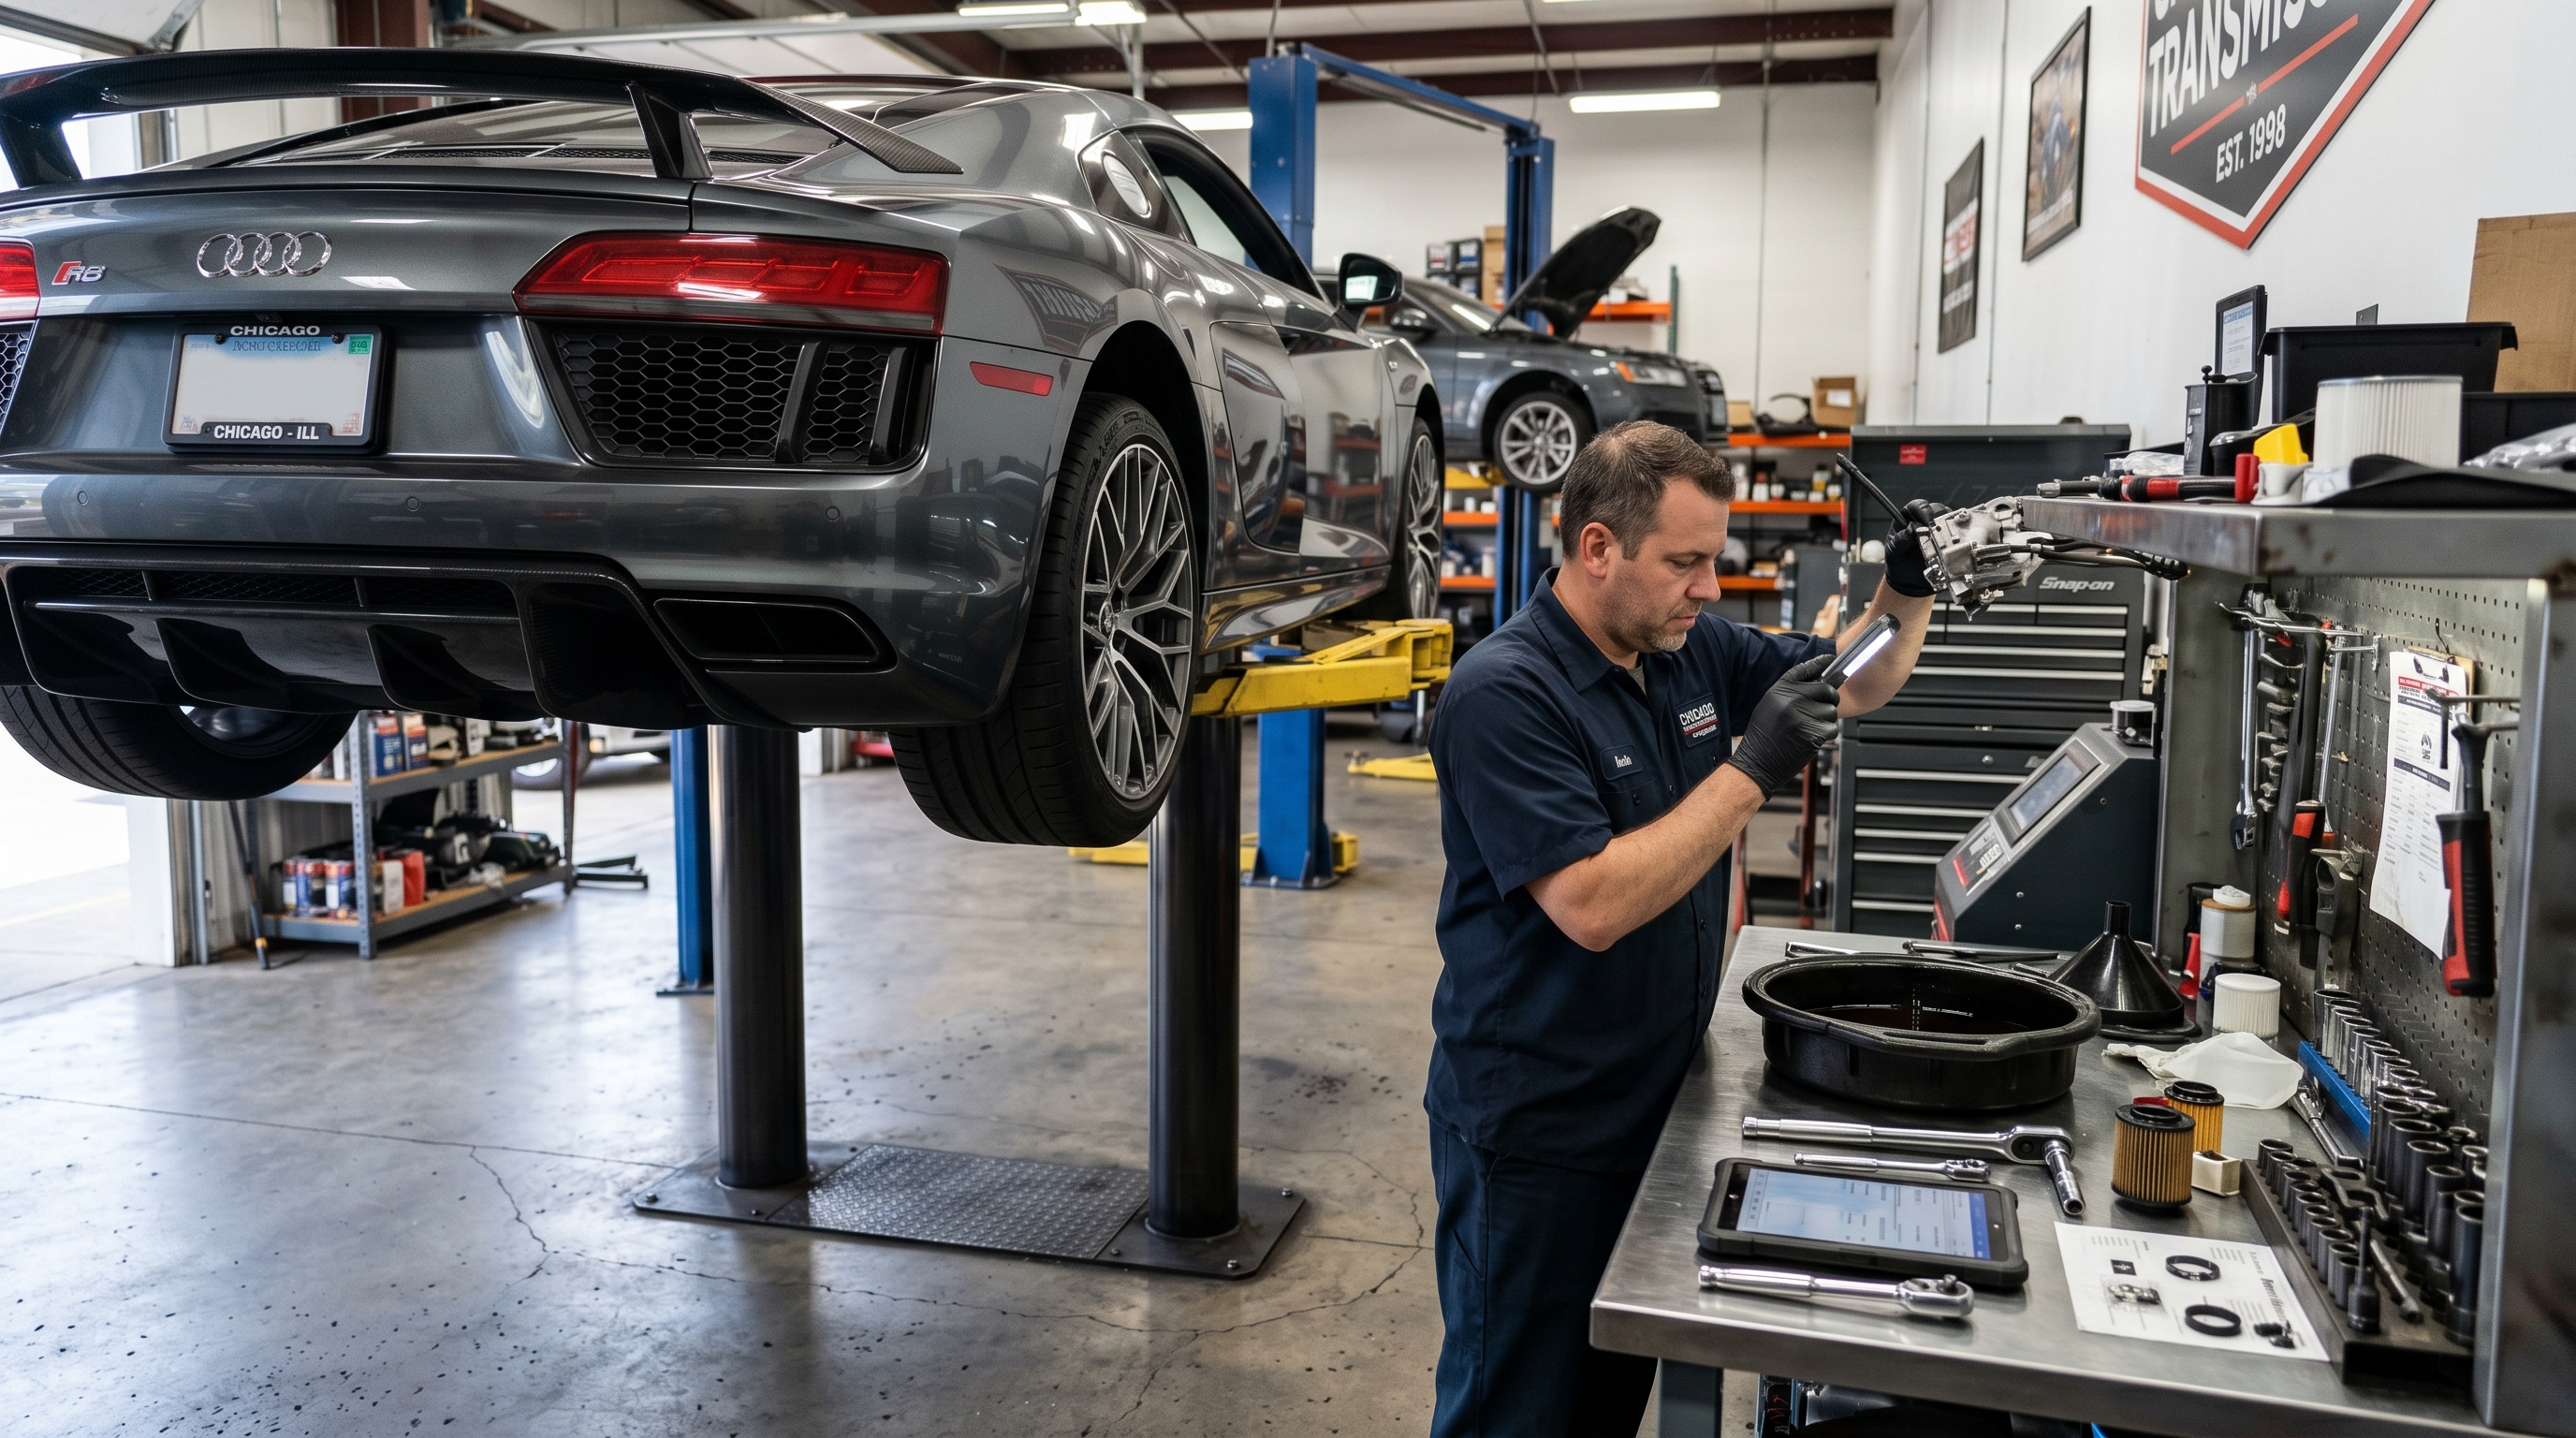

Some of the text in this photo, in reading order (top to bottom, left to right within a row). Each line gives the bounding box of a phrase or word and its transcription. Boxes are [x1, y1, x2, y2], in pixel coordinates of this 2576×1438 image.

[2149, 0, 2327, 138] TRANSM
[2216, 104, 2286, 183] EST. 1998
[51, 261, 106, 285] R8
[230, 326, 320, 335] CHICAGO
[213, 425, 283, 439] CHICAGO
[297, 426, 319, 440] ILL
[2039, 577, 2115, 593] Snap-on
